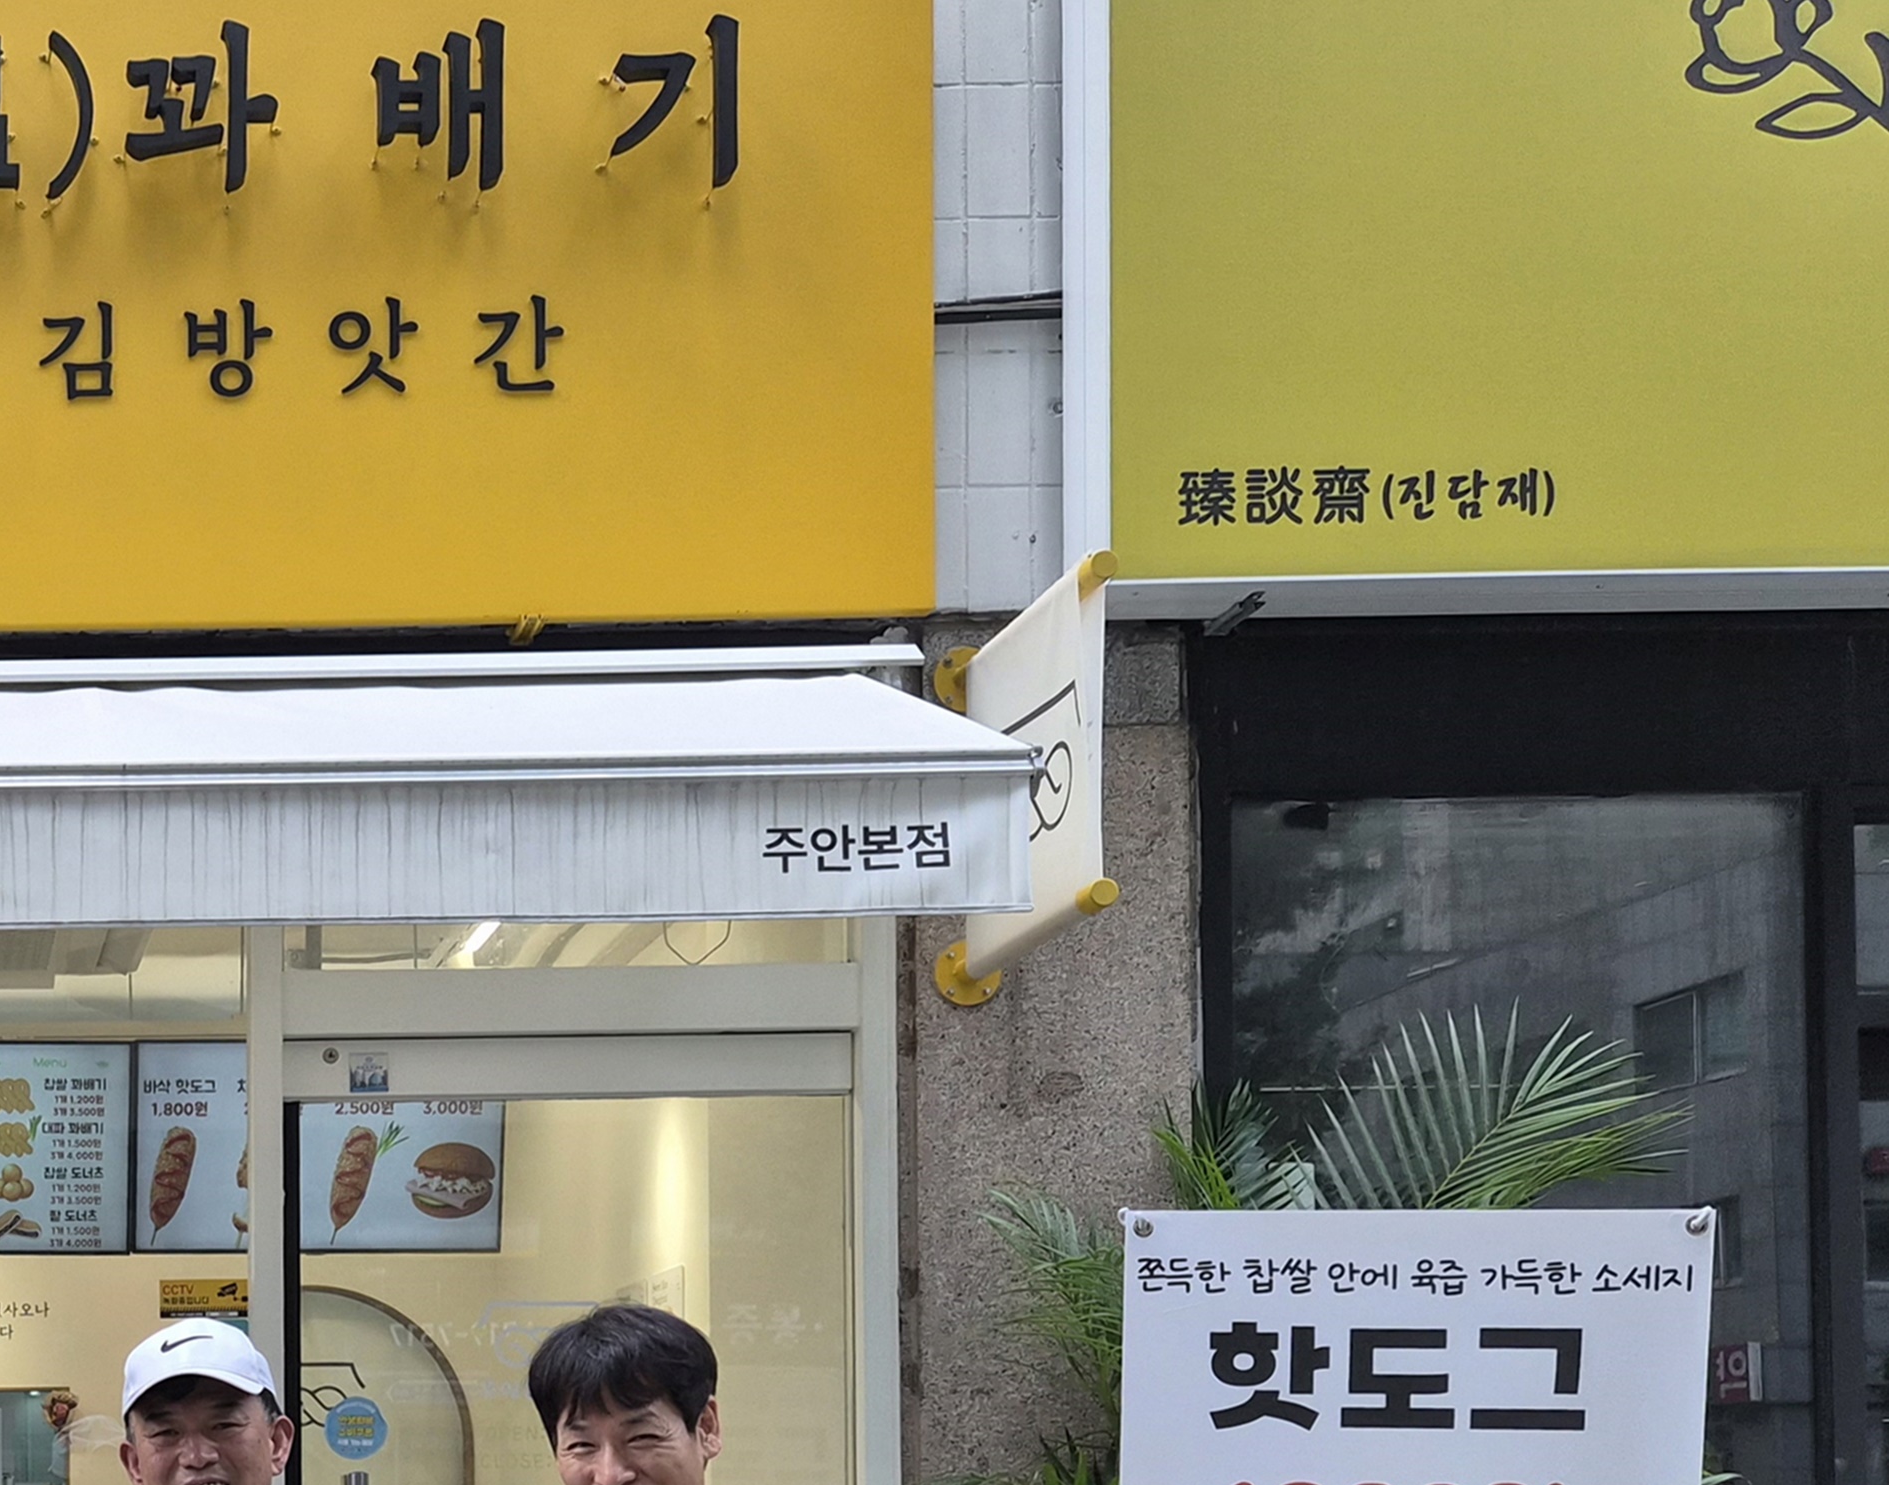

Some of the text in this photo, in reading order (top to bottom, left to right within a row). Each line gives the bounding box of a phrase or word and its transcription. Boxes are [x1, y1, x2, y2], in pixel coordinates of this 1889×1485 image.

[762, 821, 952, 873] 주안본점
[33, 1057, 67, 1068] Menu
[143, 1079, 217, 1095] 바삭 핫도그
[151, 1102, 209, 1118] 1,800원
[334, 1100, 484, 1116] 2,500원 3,000원
[71, 1166, 105, 1179] 도너츠
[64, 1210, 99, 1222] 도너츠
[1136, 1257, 1695, 1295] 쫀득한 찹쌀 안에 육즙 가득한 소세지
[162, 1285, 194, 1296] CCTV
[1208, 1320, 1587, 1432] 핫도그
